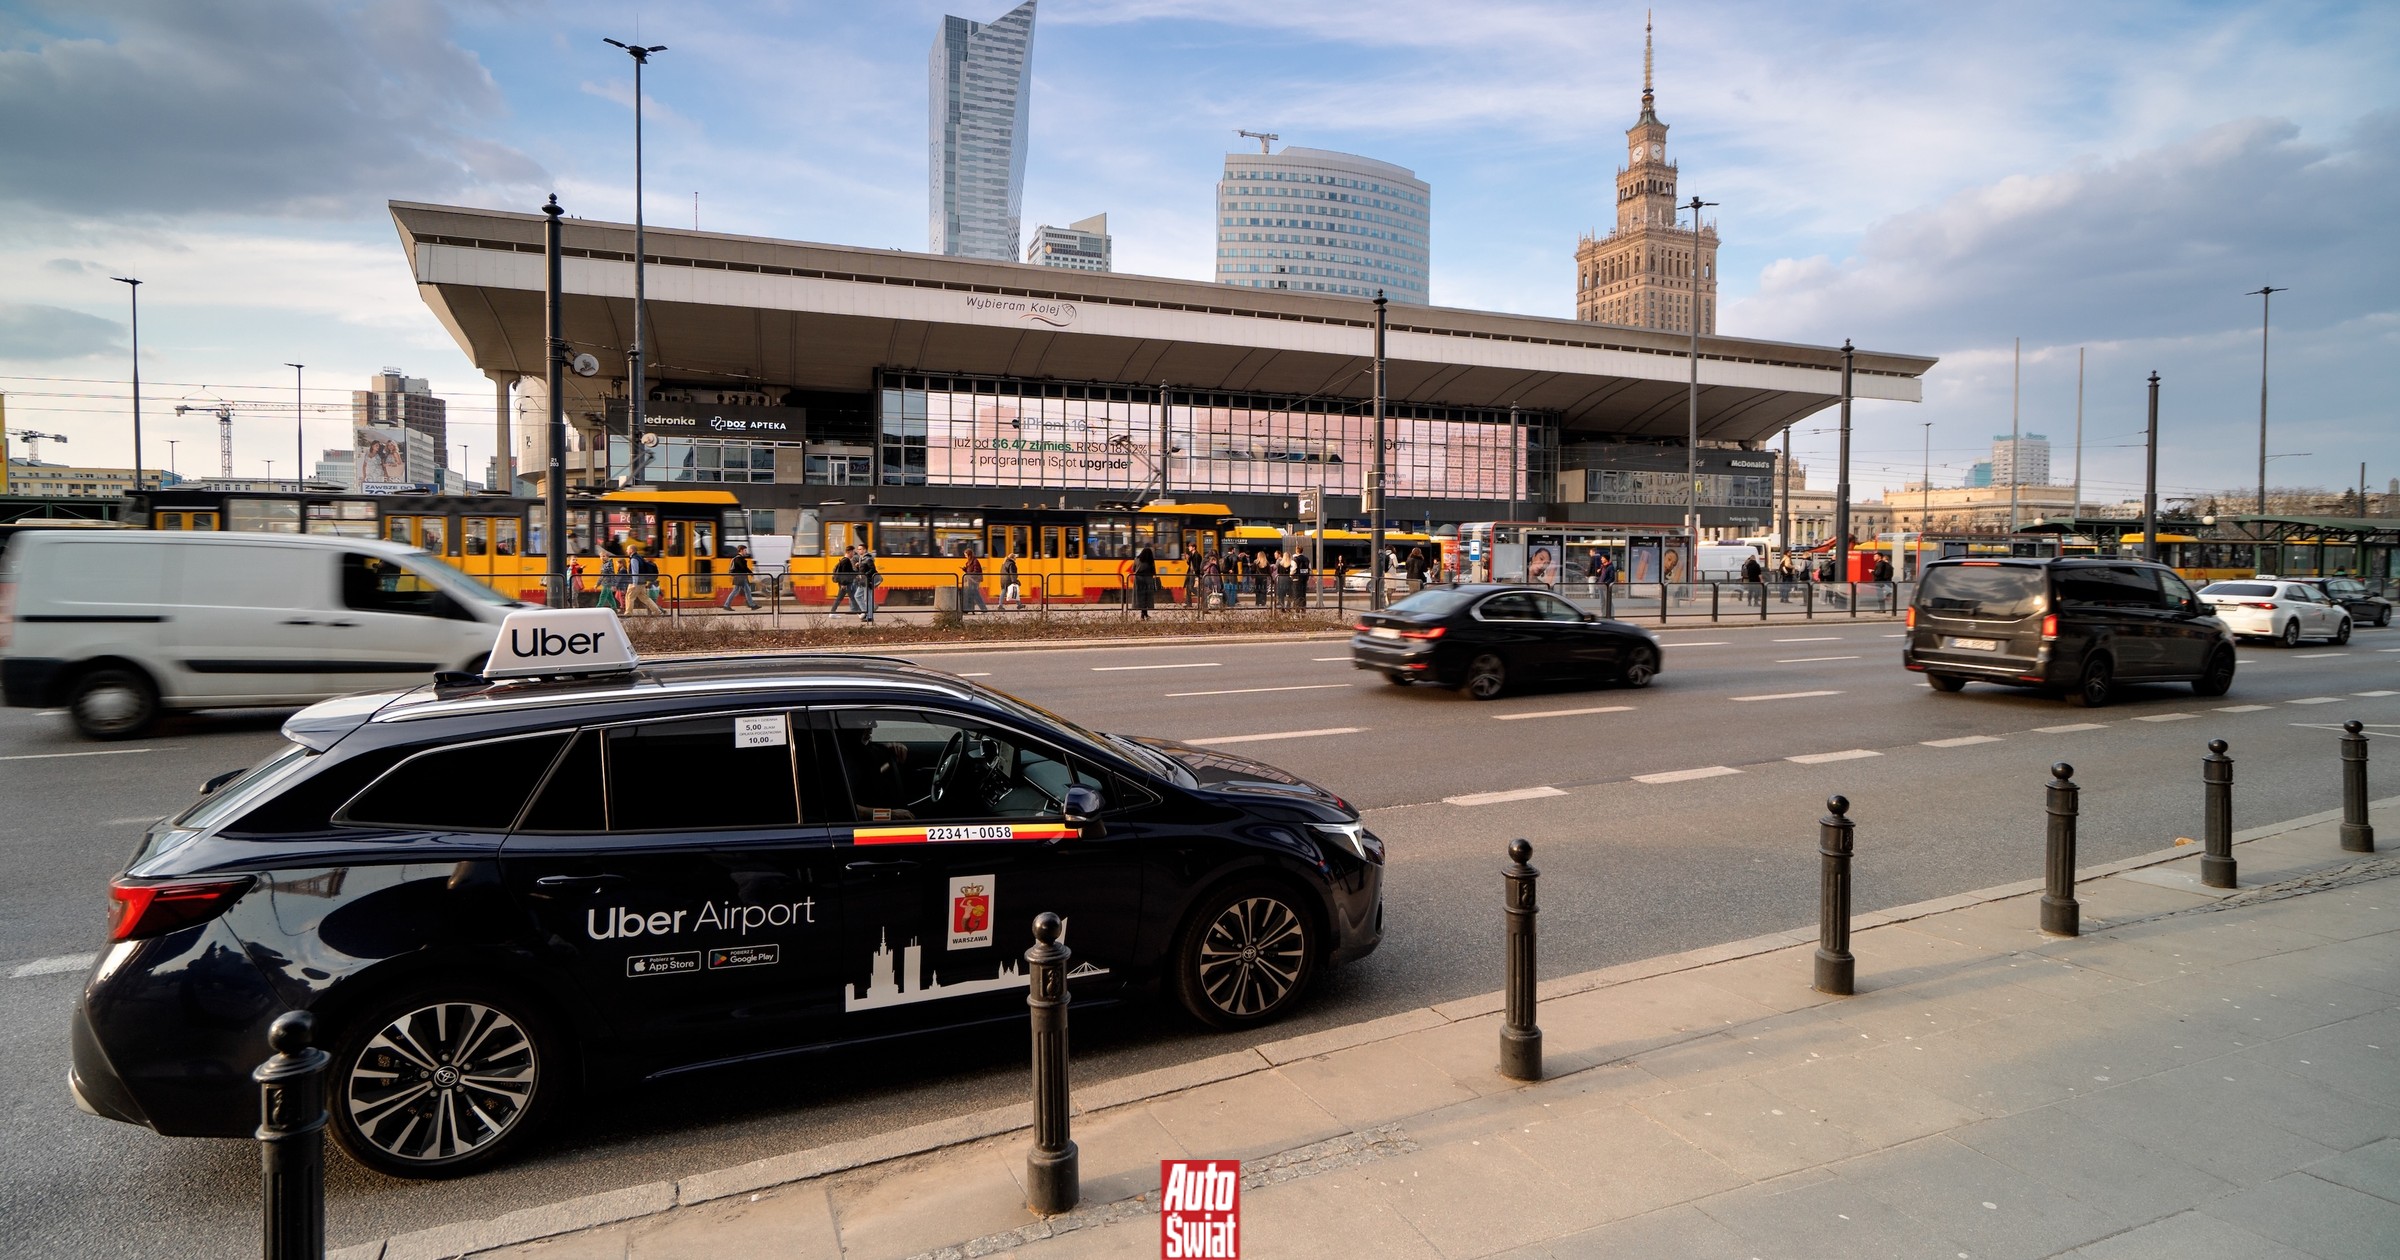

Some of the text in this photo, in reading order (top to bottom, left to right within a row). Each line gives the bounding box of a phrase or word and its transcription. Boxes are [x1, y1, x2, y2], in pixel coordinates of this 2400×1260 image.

[966, 296, 1061, 317] Wybieram Kolej
[644, 414, 696, 426] iedronka
[726, 420, 787, 430] DOZ APTEKA
[1023, 417, 1070, 431] iPhone
[953, 437, 971, 449] już
[974, 438, 989, 449] od
[1076, 442, 1108, 453] RRSO
[1369, 434, 1407, 454] ipot
[979, 455, 1045, 468] programem
[1048, 456, 1077, 469] iSpot
[1731, 460, 1770, 469] McDonald's
[512, 627, 605, 658] Uber
[749, 736, 769, 744] 10,00
[928, 826, 1012, 841] 22341-0058
[587, 896, 815, 940] Uber Airport
[952, 935, 988, 945] WARSZAWA
[730, 952, 774, 964] Google Play
[649, 960, 695, 971] App Store
